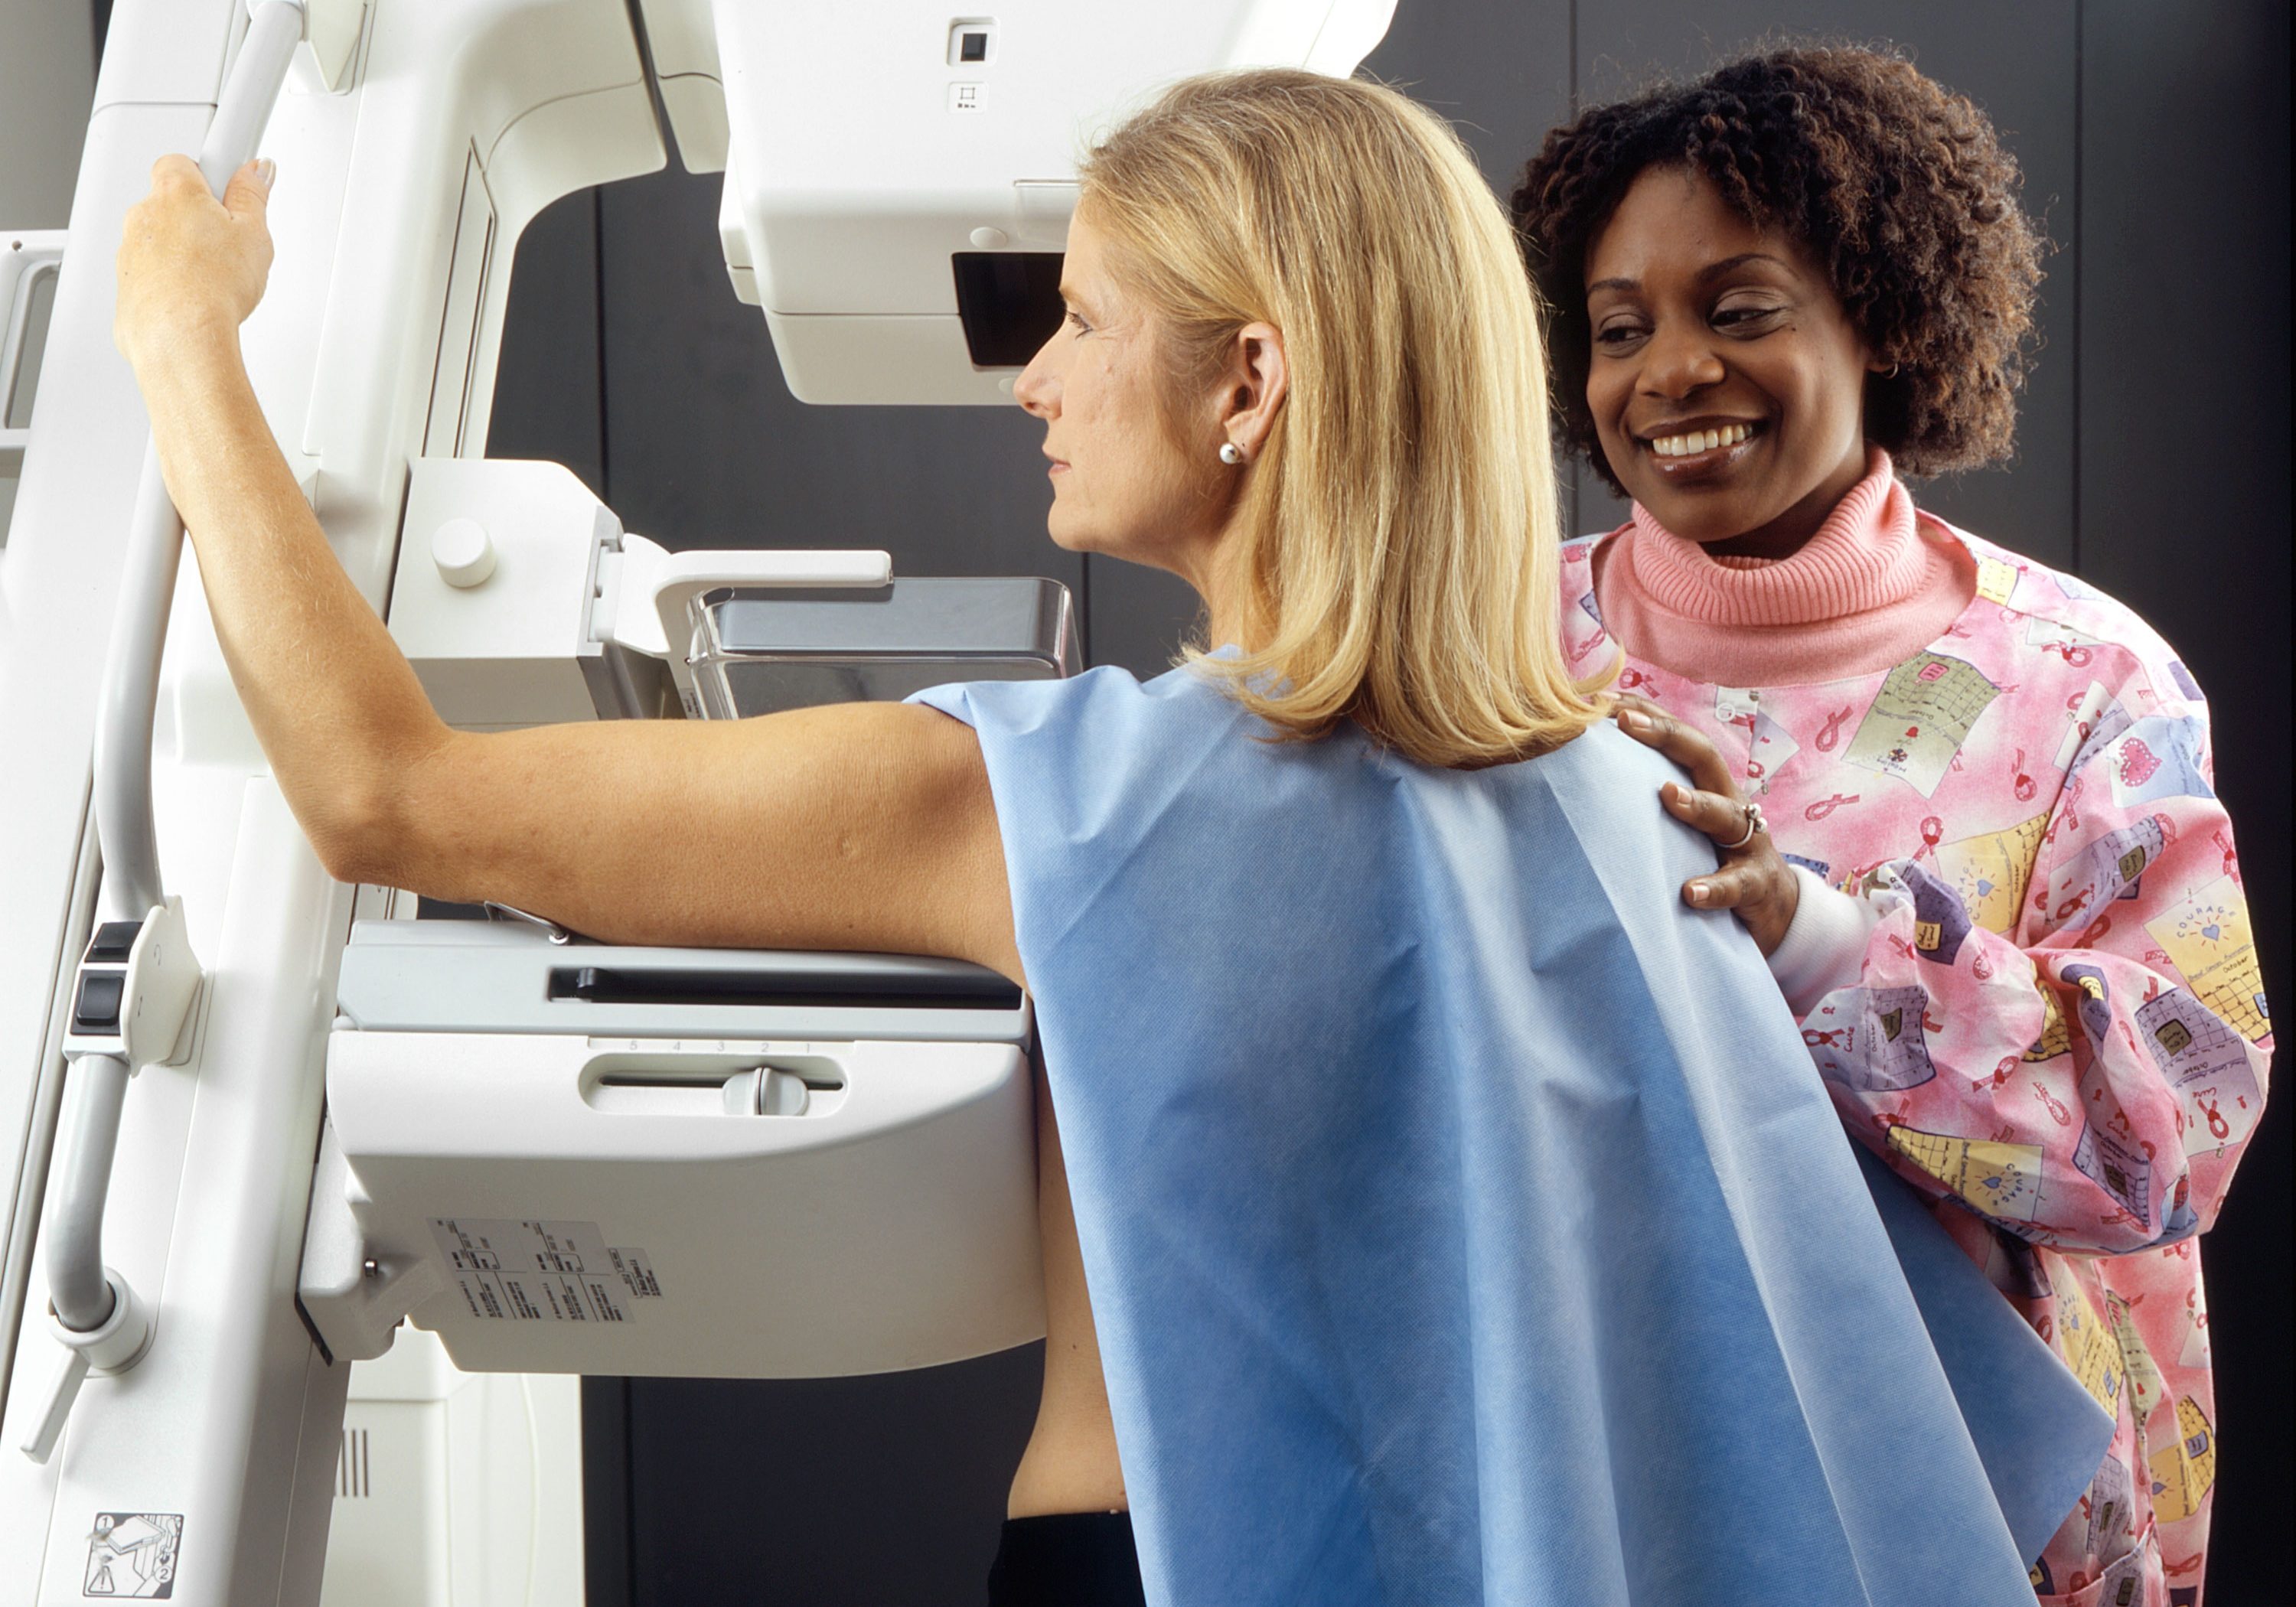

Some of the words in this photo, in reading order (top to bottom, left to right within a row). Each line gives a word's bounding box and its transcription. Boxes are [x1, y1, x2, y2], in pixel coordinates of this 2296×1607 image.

[2177, 905, 2236, 939] COURAGE
[2223, 956, 2249, 973] October
[1844, 1026, 1854, 1052] Cure
[630, 1041, 637, 1051] 5
[673, 1041, 681, 1051] 4
[717, 1041, 725, 1051] 3
[761, 1042, 769, 1053] 2
[806, 1044, 810, 1053] 1
[2183, 1061, 2208, 1075] October
[2193, 1087, 2216, 1098] Cure
[2107, 1121, 2128, 1140] Cure
[1993, 1162, 2023, 1206] COURAGE
[103, 1517, 108, 1527] 1
[159, 1568, 169, 1580] 2
